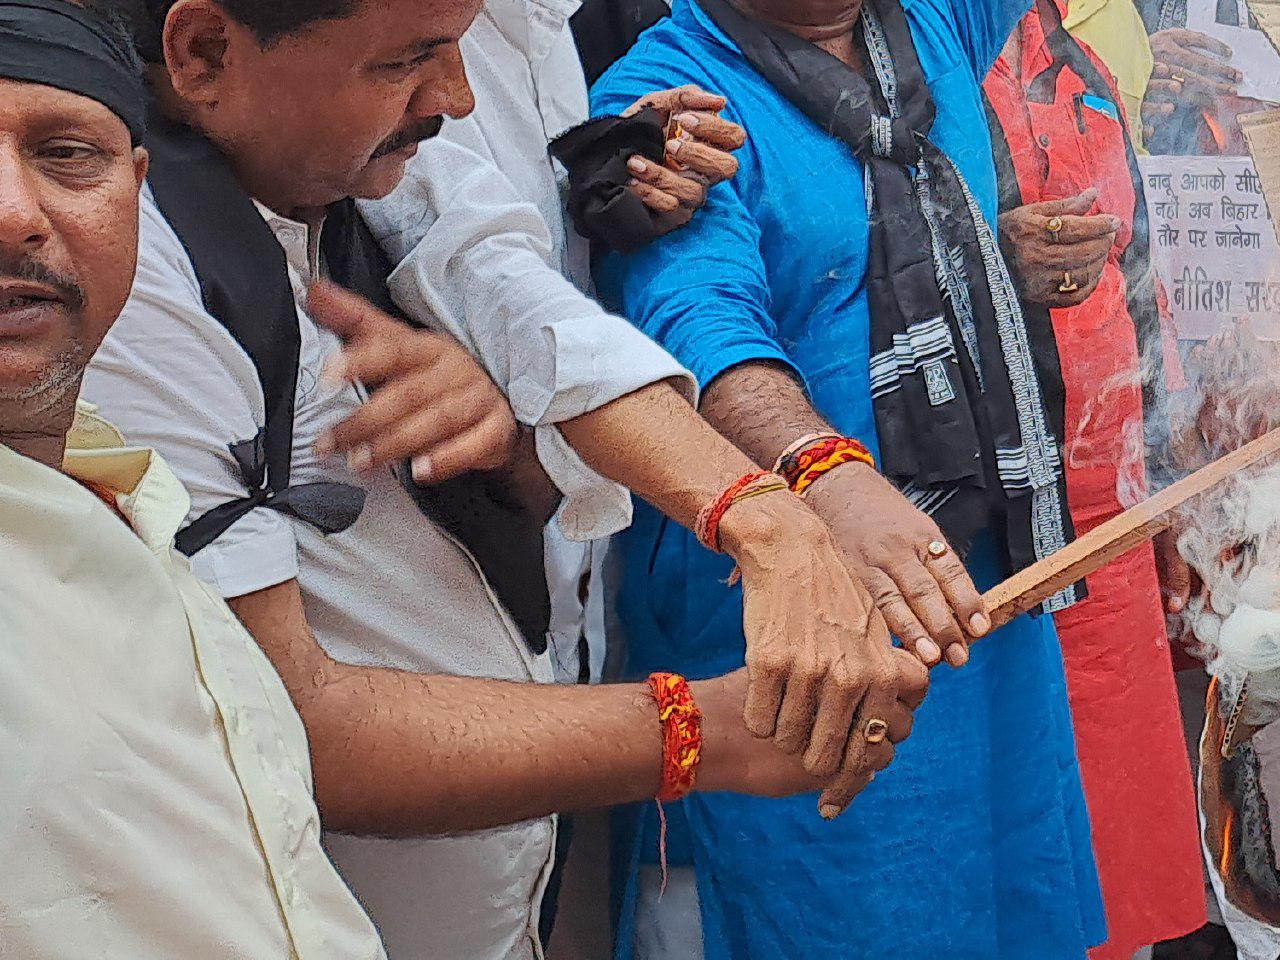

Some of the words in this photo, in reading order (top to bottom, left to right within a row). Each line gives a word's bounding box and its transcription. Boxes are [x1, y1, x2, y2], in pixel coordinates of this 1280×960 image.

[1148, 174, 1174, 196] बाबू
[1181, 167, 1226, 191] आपको
[1188, 202, 1213, 219] अब
[1221, 195, 1259, 221] बिहार
[1157, 223, 1179, 247] तौर
[1188, 228, 1208, 247] पर
[1215, 224, 1260, 249] जानेगा
